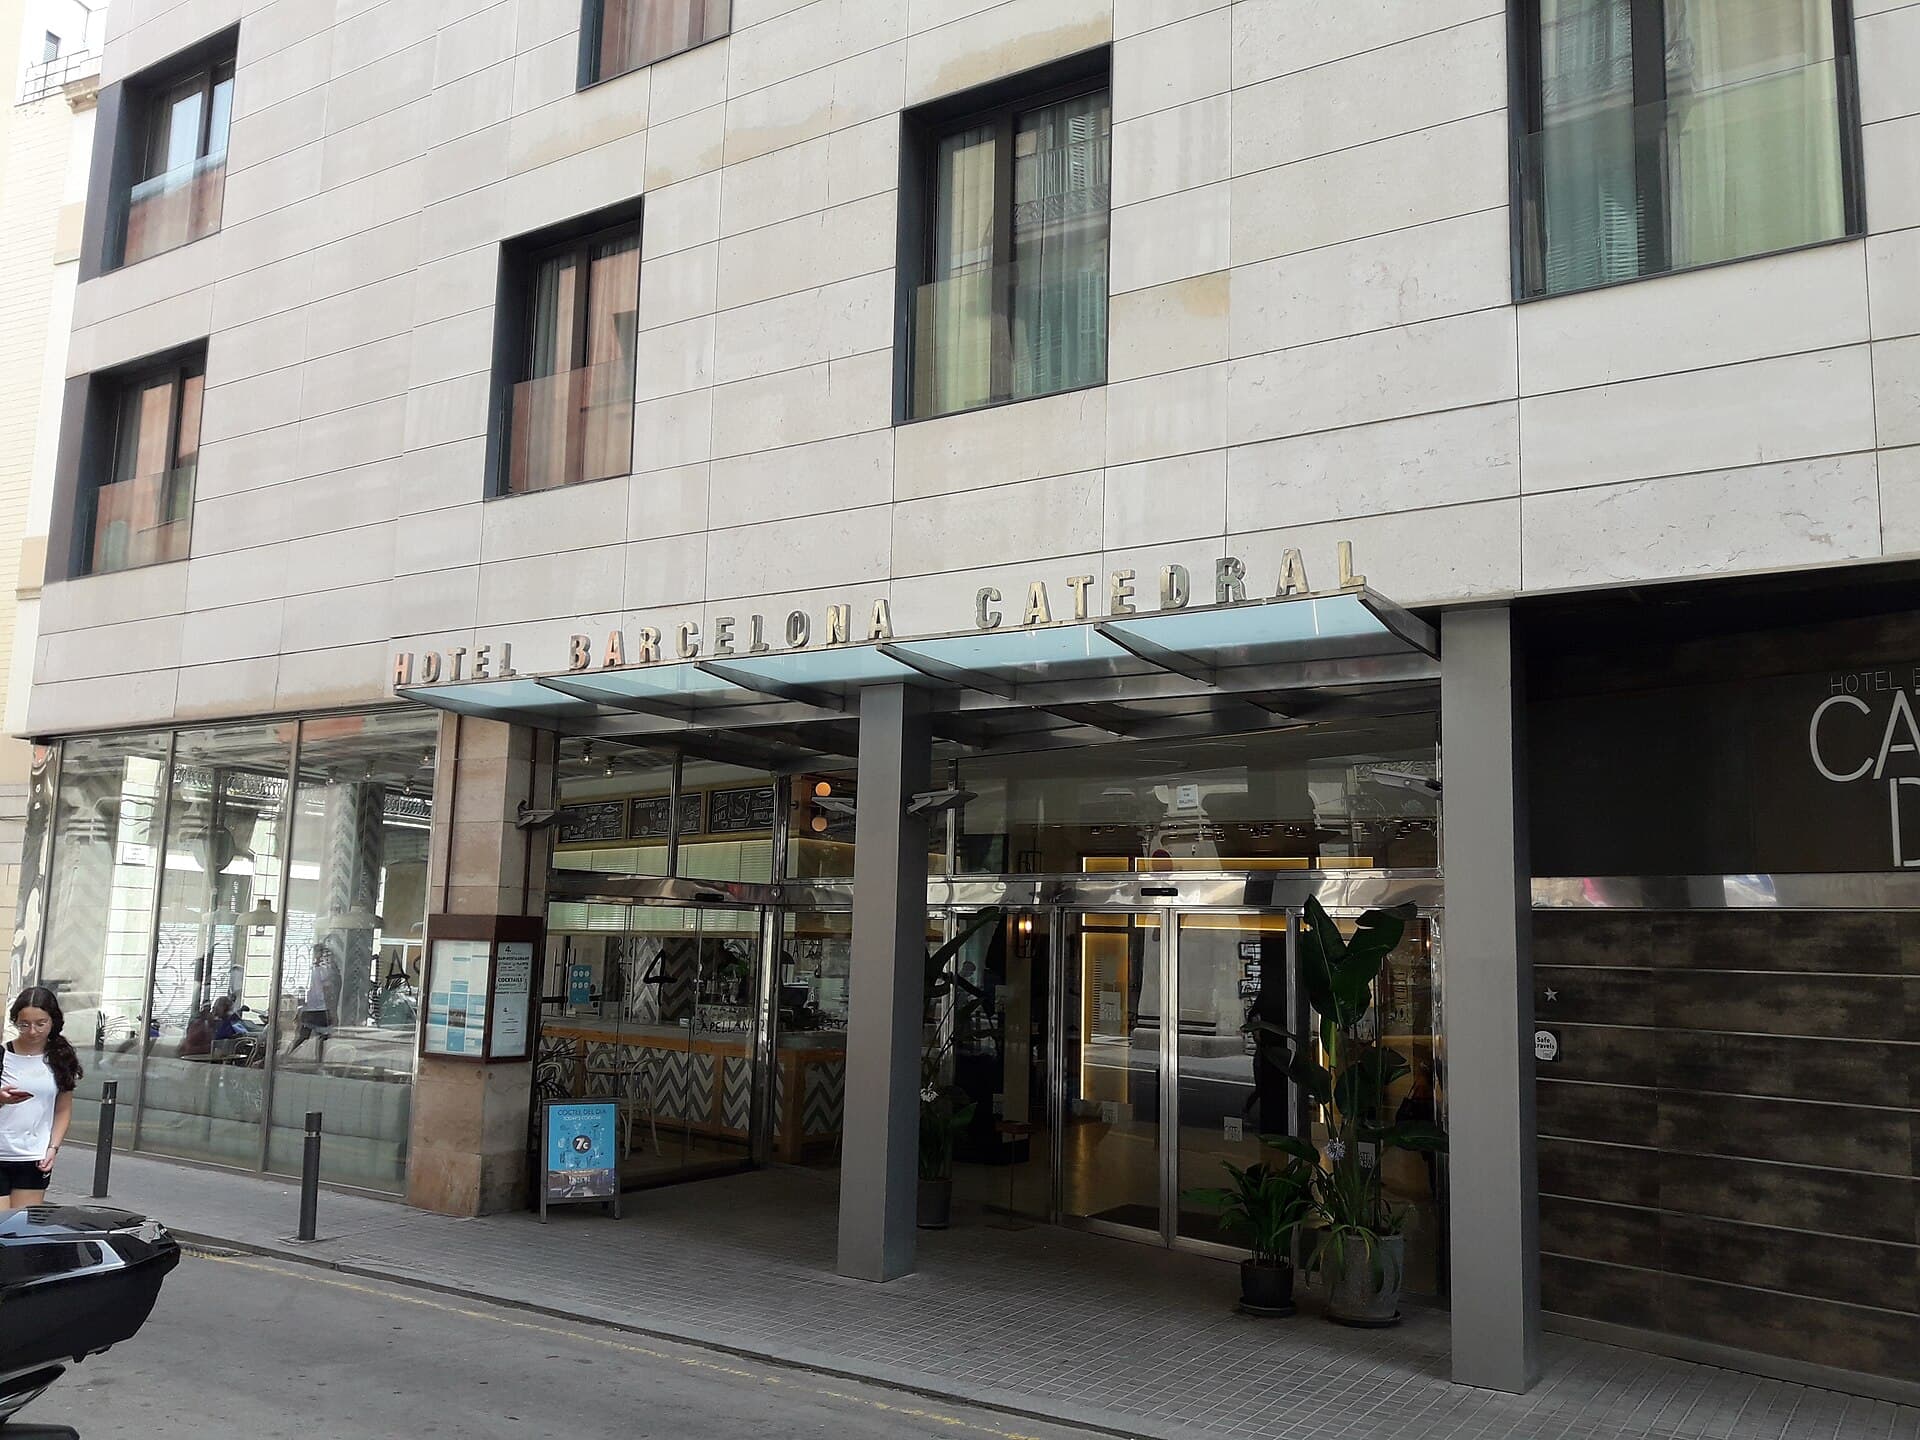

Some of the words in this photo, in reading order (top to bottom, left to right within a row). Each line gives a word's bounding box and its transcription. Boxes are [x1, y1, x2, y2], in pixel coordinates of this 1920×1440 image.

[393, 642, 516, 685] HOTEL
[569, 598, 892, 670] BARCELONA
[975, 540, 1367, 629] CATEDRAL
[1830, 671, 1903, 694] HOTEL
[643, 948, 677, 1007] 4
